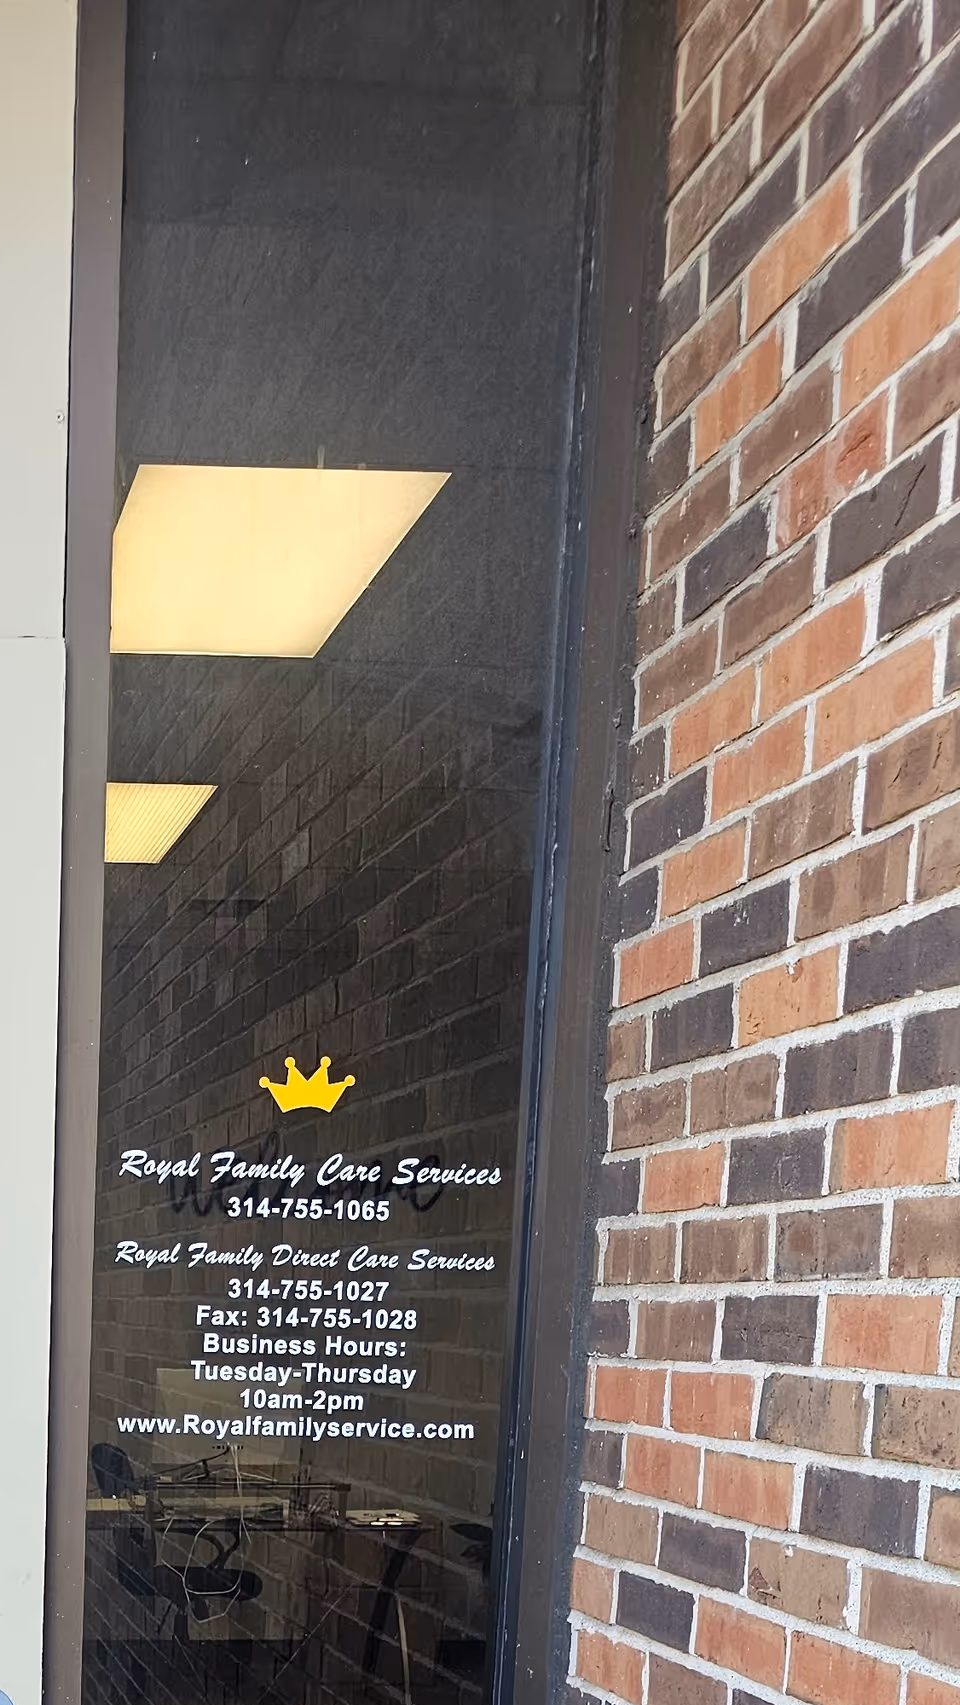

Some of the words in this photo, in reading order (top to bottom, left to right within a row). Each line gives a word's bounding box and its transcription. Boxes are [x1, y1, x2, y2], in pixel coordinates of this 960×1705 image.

[118, 1149, 200, 1185] Royal
[210, 1151, 305, 1188] Family
[316, 1153, 381, 1187] Care
[391, 1157, 502, 1185] Services
[227, 1196, 390, 1222] 314-755-1065
[114, 1240, 182, 1269] Royal
[187, 1242, 264, 1272] Family
[271, 1244, 341, 1268] Direct
[347, 1245, 399, 1272] Care
[407, 1248, 495, 1271] Services
[227, 1278, 390, 1302] 314-755-1027
[196, 1304, 247, 1327] Fax:
[256, 1306, 417, 1330] 314-755-1028
[203, 1332, 316, 1356] Business
[325, 1335, 406, 1357] Hours:
[190, 1359, 417, 1388] Tuesday-Thursday
[239, 1388, 364, 1414] 10am-2pm
[117, 1412, 475, 1442] www.Royalfamilyservice.com
